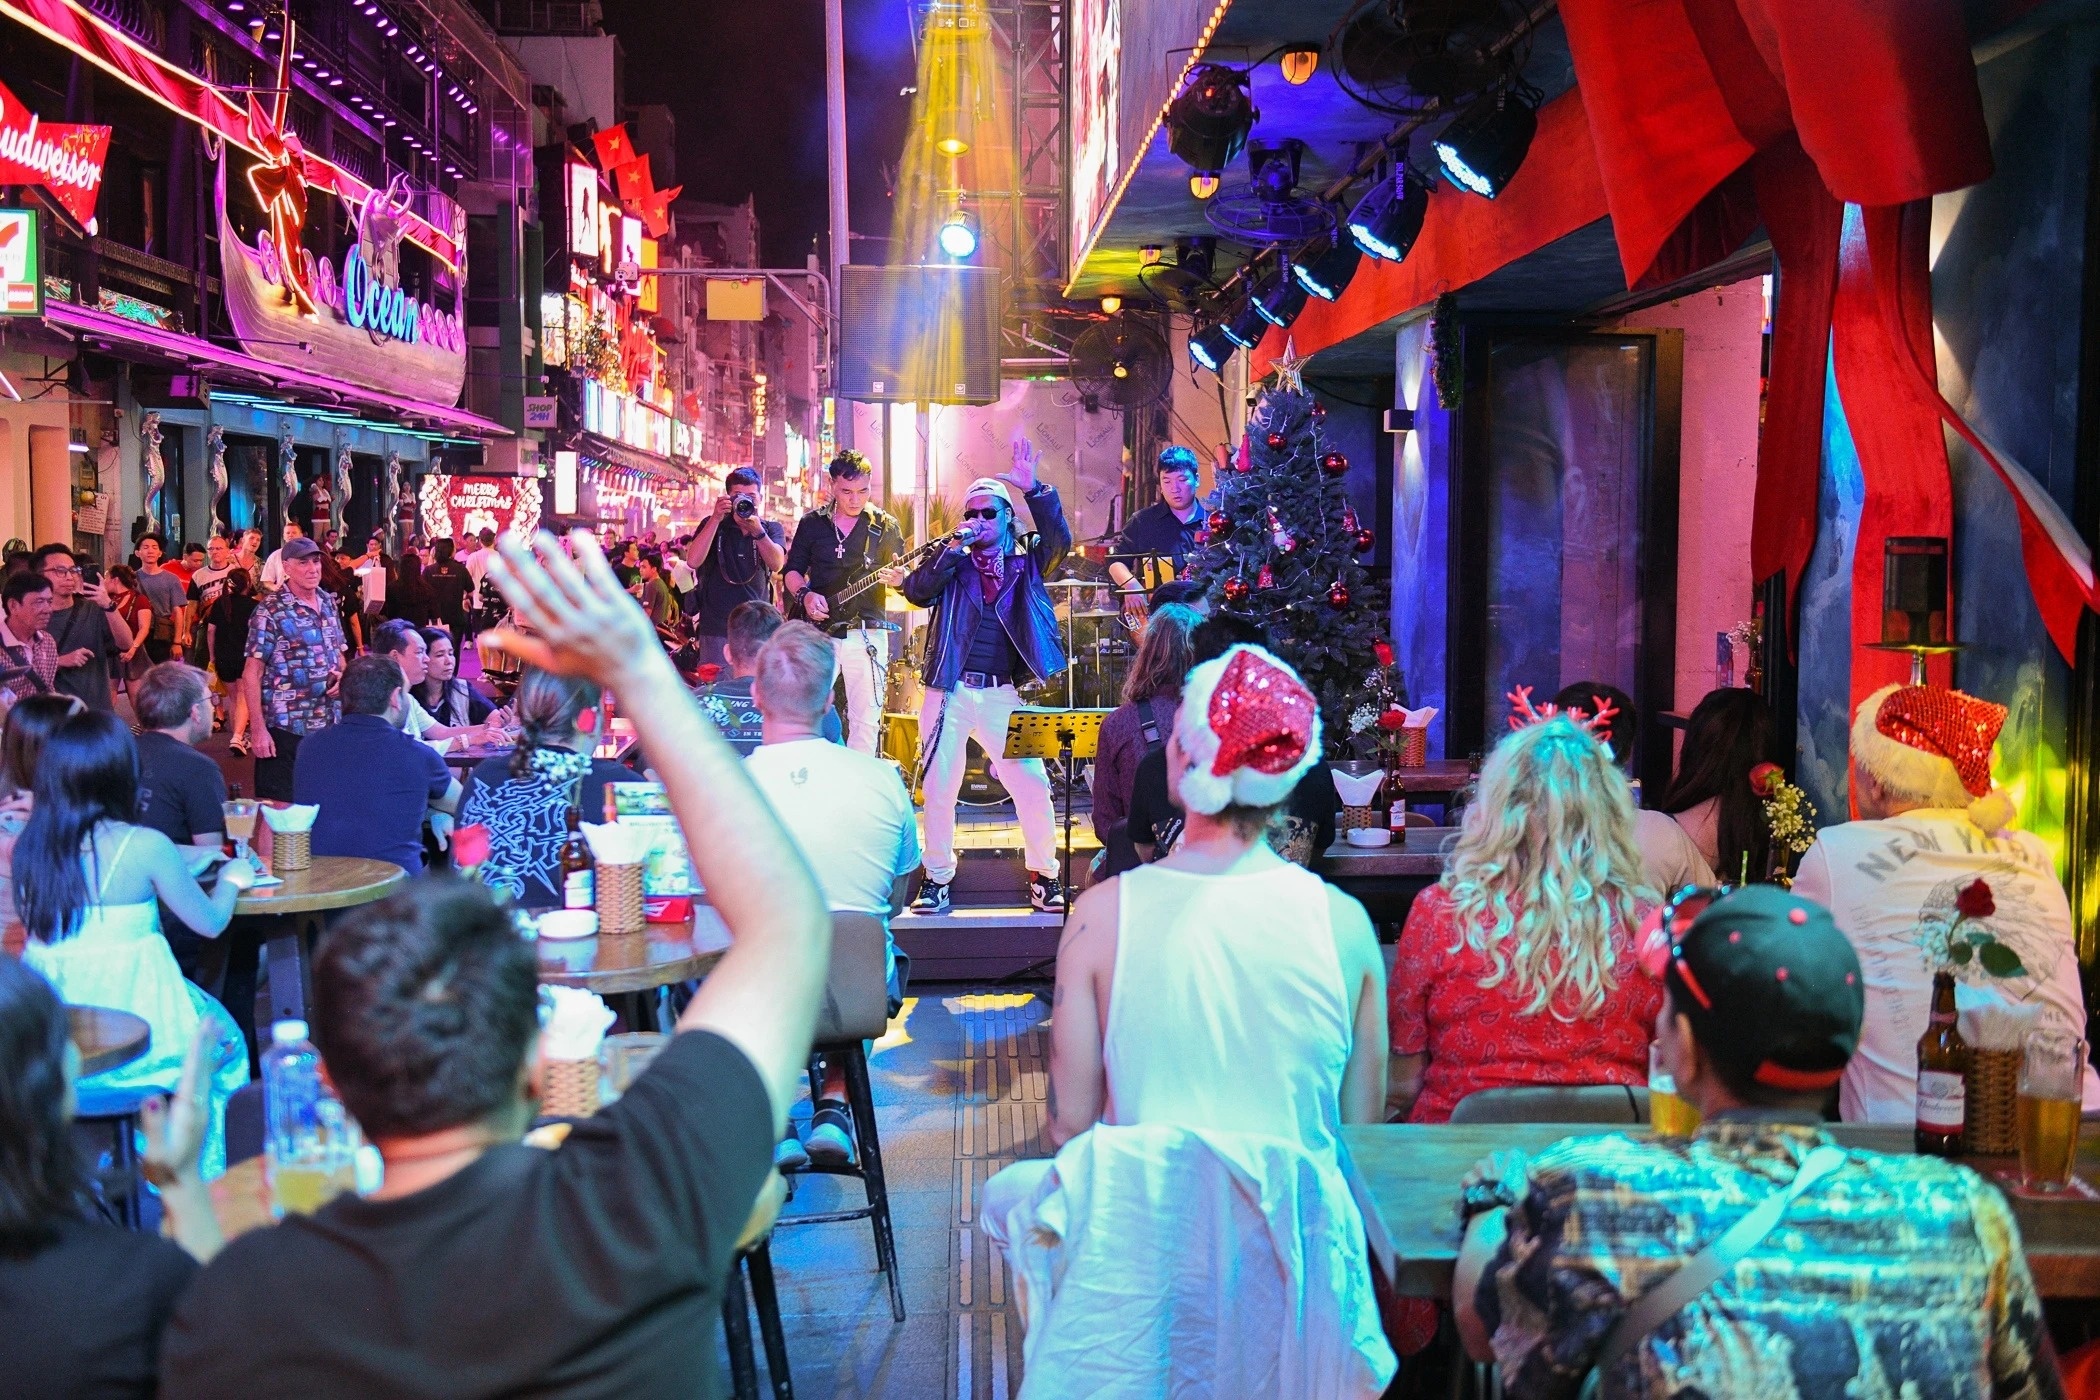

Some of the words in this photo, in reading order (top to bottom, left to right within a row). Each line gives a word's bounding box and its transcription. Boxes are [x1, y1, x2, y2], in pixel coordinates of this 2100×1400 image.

[0, 96, 102, 191] udweiser
[343, 243, 420, 345] Ocean
[526, 403, 553, 412] SHOP
[529, 411, 550, 421] 24H
[463, 482, 500, 498] MERRY
[450, 495, 513, 509] CHRISTMAS
[1854, 827, 1943, 883] NEW
